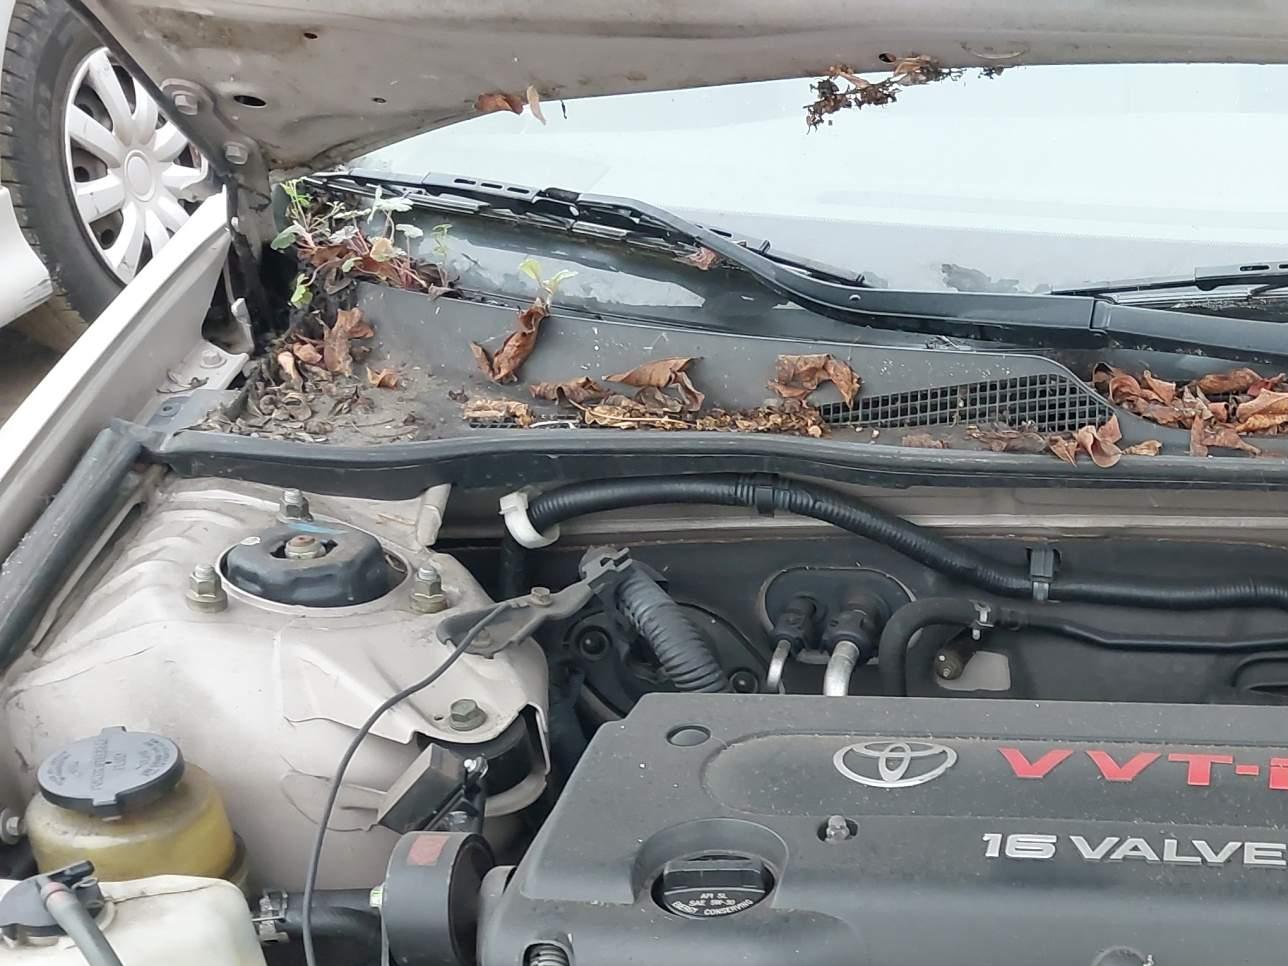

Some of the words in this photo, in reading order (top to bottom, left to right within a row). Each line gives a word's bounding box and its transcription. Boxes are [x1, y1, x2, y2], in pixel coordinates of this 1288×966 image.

[982, 832, 1058, 859] 16
[1069, 834, 1288, 867] VALVE
[704, 900, 753, 915] CONSERVING
